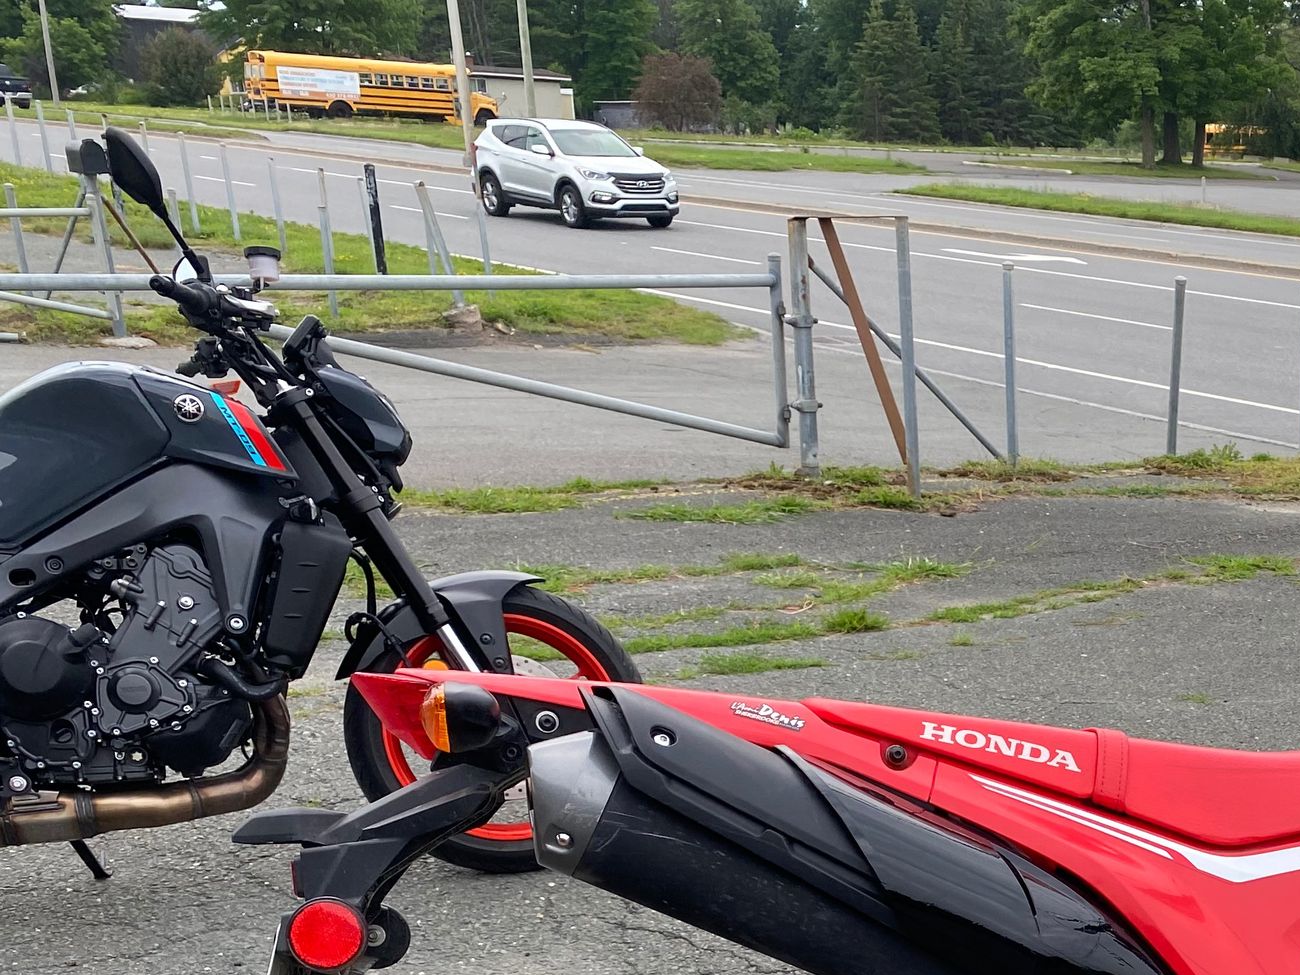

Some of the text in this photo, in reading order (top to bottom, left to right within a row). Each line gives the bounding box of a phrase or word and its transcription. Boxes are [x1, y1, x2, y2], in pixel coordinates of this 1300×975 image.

[220, 406, 257, 455] MT-09
[758, 703, 805, 728] Denis
[920, 721, 1082, 773] HONDA
